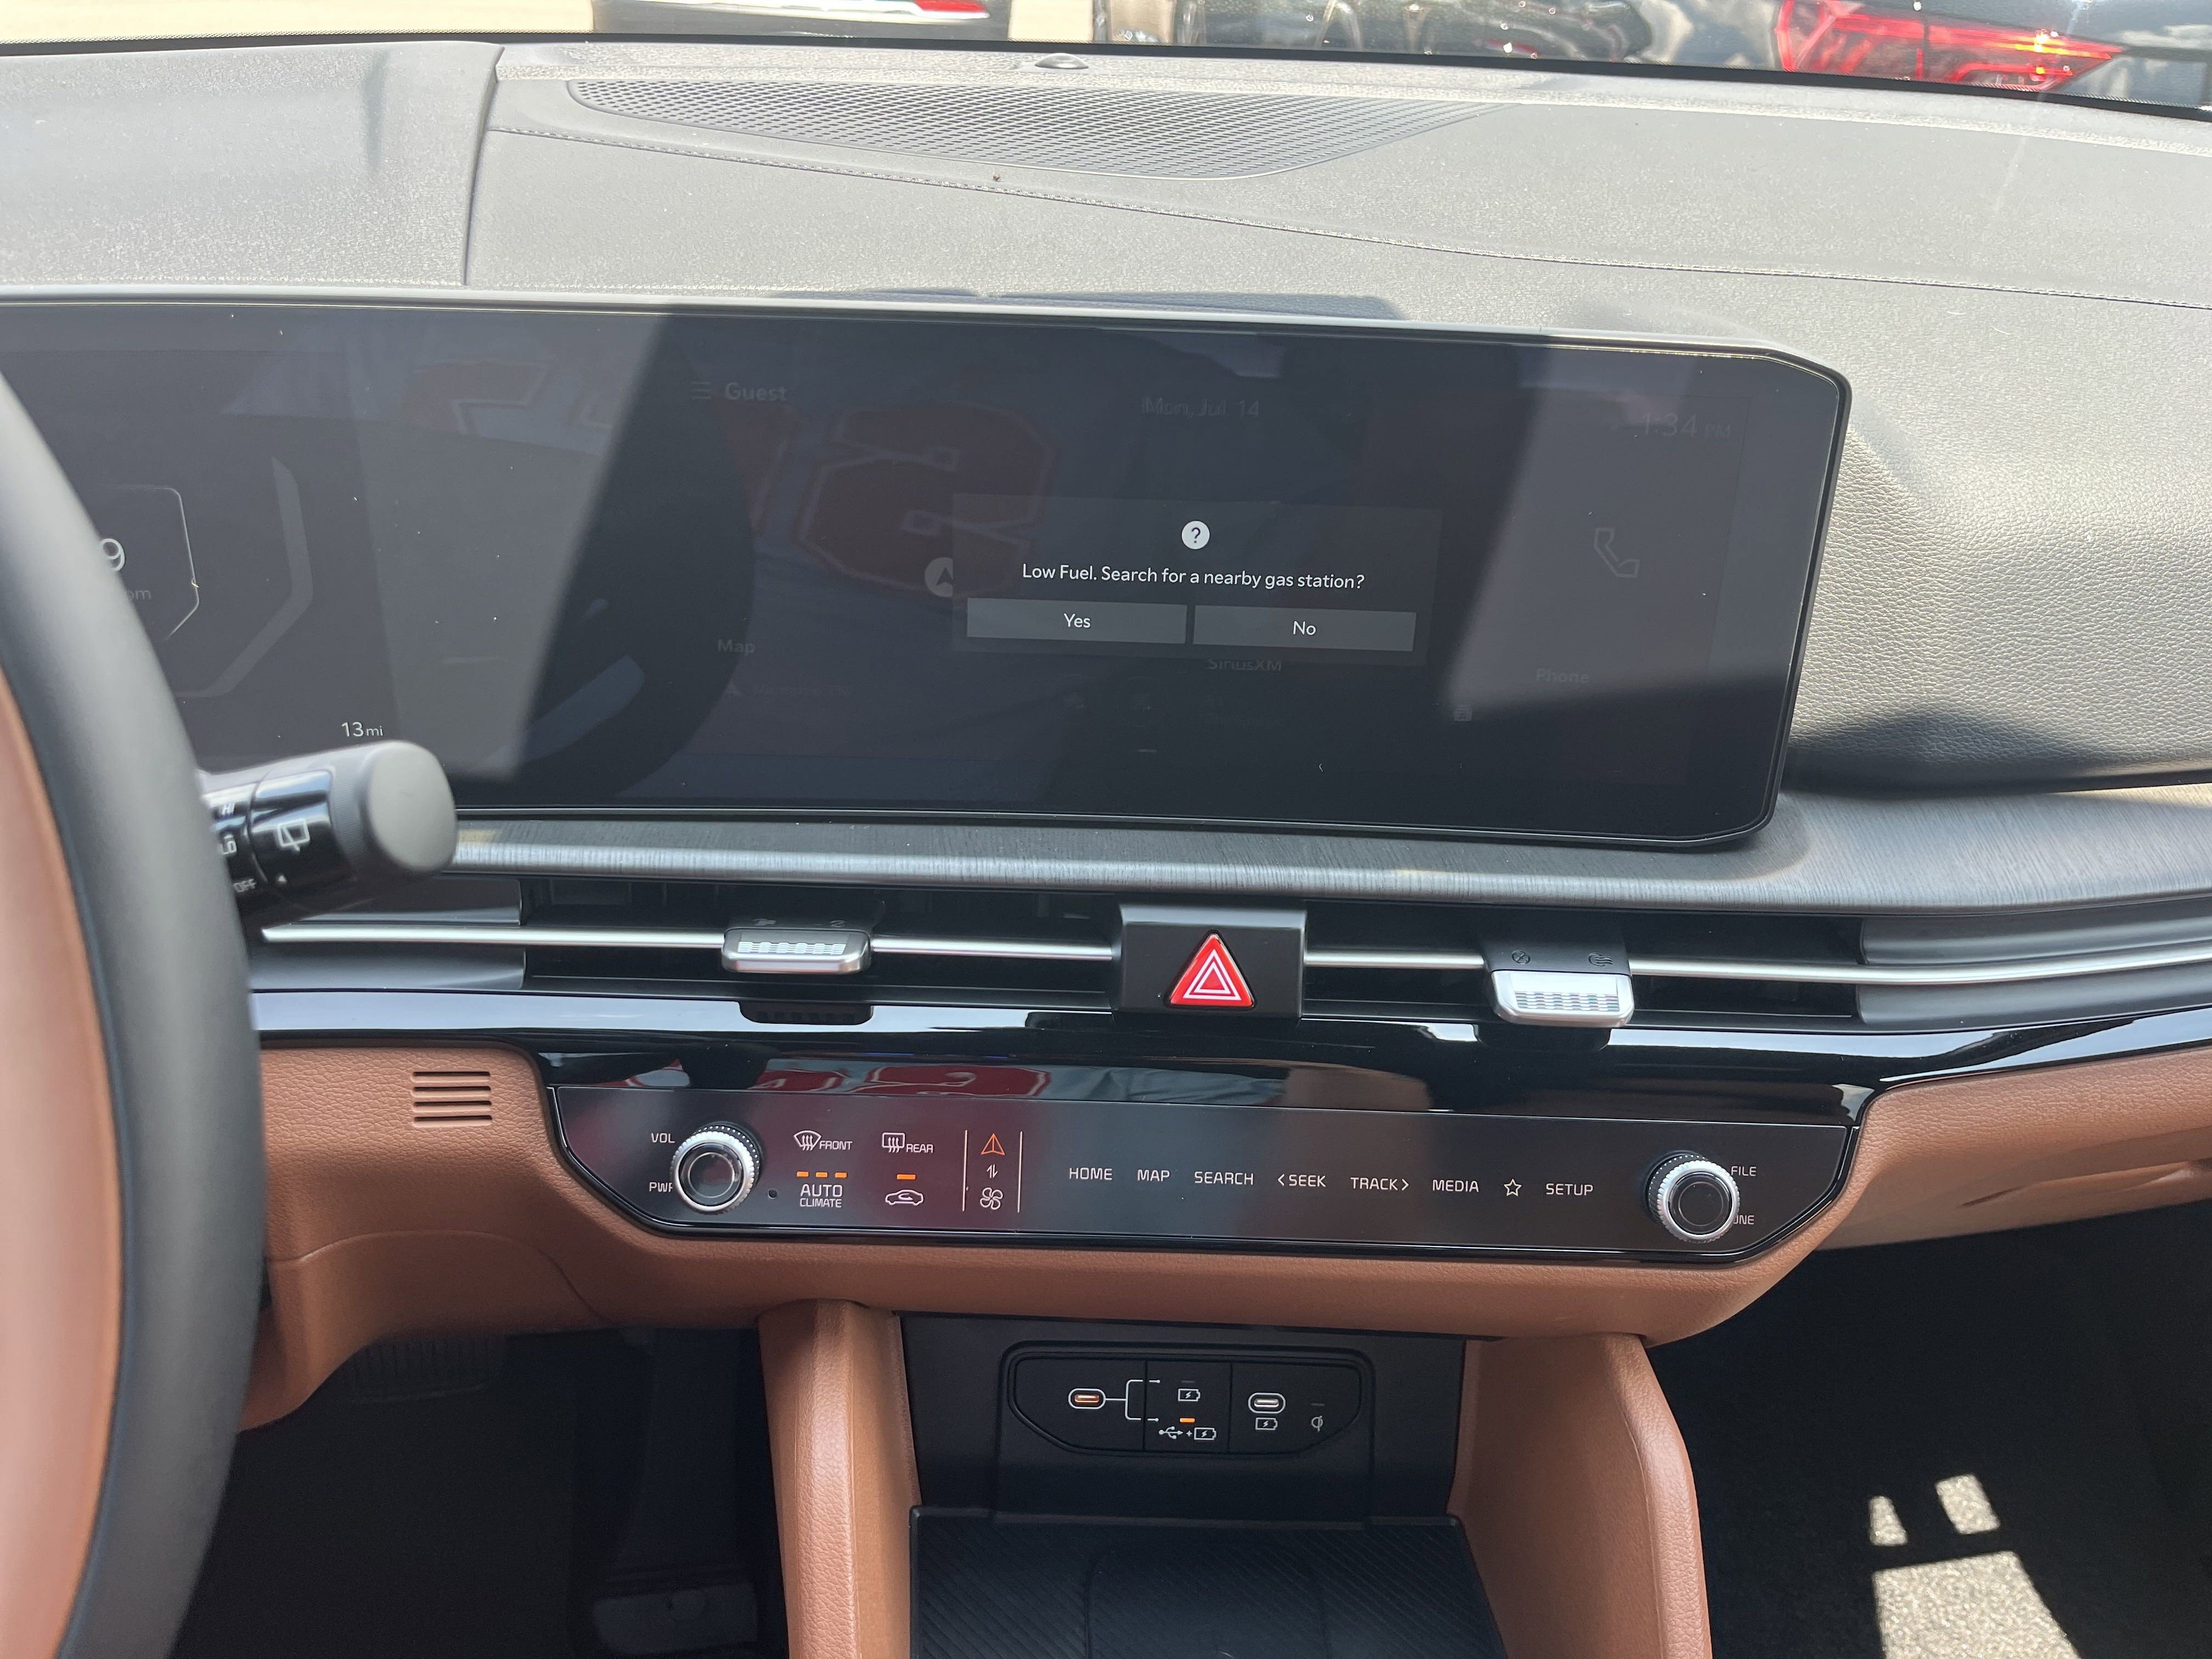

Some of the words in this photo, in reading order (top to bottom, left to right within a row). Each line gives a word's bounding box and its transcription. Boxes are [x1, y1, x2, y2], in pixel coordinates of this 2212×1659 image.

[725, 381, 787, 401] Guest
[1142, 396, 1194, 419] Mon,
[1238, 400, 1260, 417] 14
[1643, 411, 1697, 438] 1:34
[1704, 424, 1731, 438] PM
[1023, 564, 1056, 579] Low
[1060, 565, 1098, 581] Fuel.
[1102, 566, 1158, 583] Search
[1162, 568, 1187, 583] for
[1190, 573, 1199, 584] a
[1204, 571, 1261, 589] nearby
[1265, 575, 1294, 589] gas
[1297, 574, 1365, 589] station?
[1064, 613, 1091, 628] Yes
[1293, 620, 1316, 636] No
[718, 639, 757, 656] Map
[1536, 667, 1590, 684] Phone
[233, 878, 256, 893] OFF
[651, 1132, 675, 1143] VOL
[819, 1139, 853, 1150] FRONT
[905, 1143, 934, 1154] REAR
[1069, 1167, 1113, 1181] HOME
[1137, 1169, 1170, 1182] MAP
[1194, 1171, 1254, 1185] SEARCH
[1731, 1166, 1757, 1177] FILE
[800, 1183, 843, 1198] AUTO
[1432, 1180, 1480, 1193] MEDIA
[1545, 1183, 1594, 1197] SETUP
[799, 1198, 842, 1208] CLIMATE
[1734, 1215, 1754, 1225] UNE
